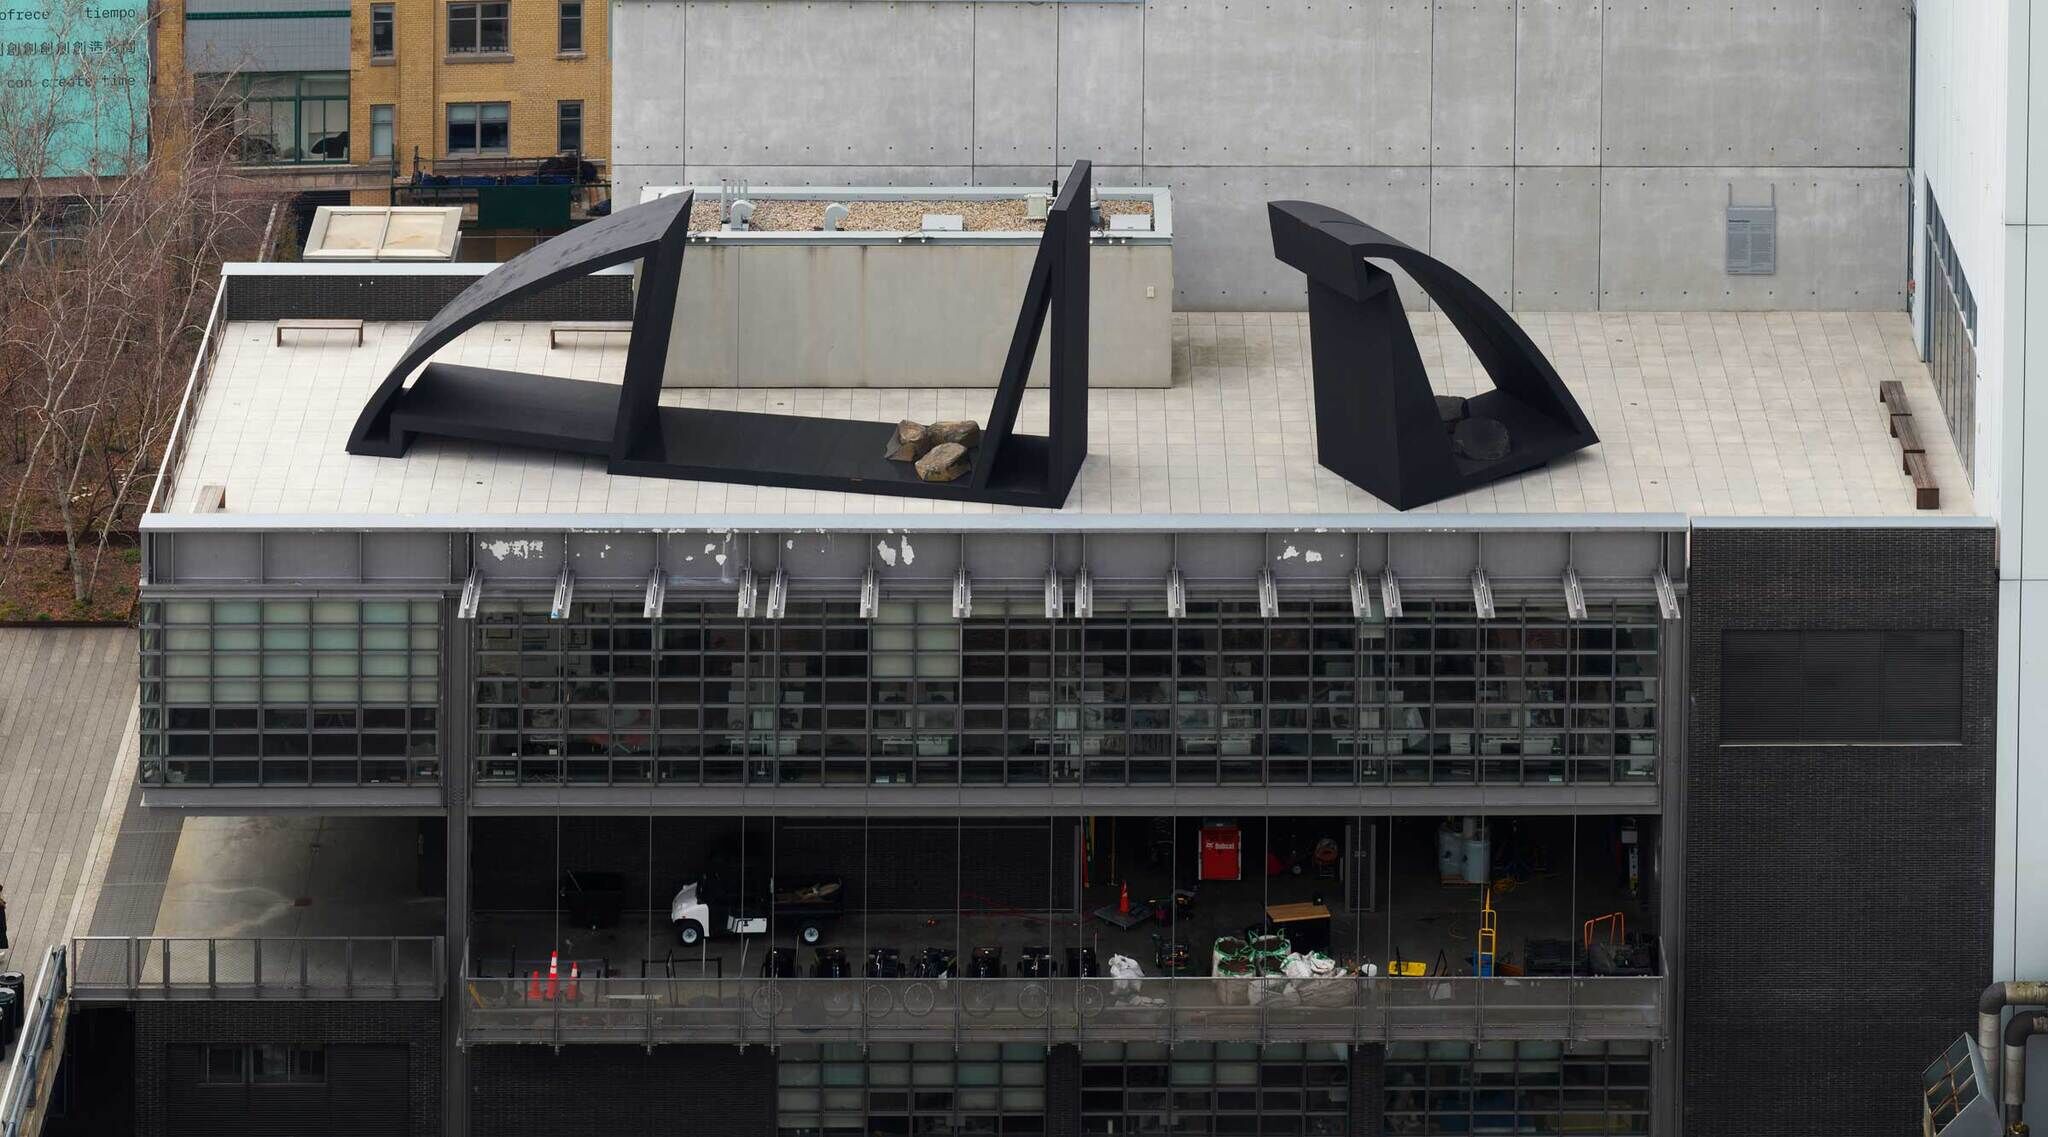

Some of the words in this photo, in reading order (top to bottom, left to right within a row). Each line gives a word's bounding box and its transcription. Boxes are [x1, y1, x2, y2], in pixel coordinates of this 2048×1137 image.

[0, 9, 49, 20] ofrece
[86, 7, 136, 20] tiempo
[7, 78, 32, 88] can
[102, 74, 136, 86] time
